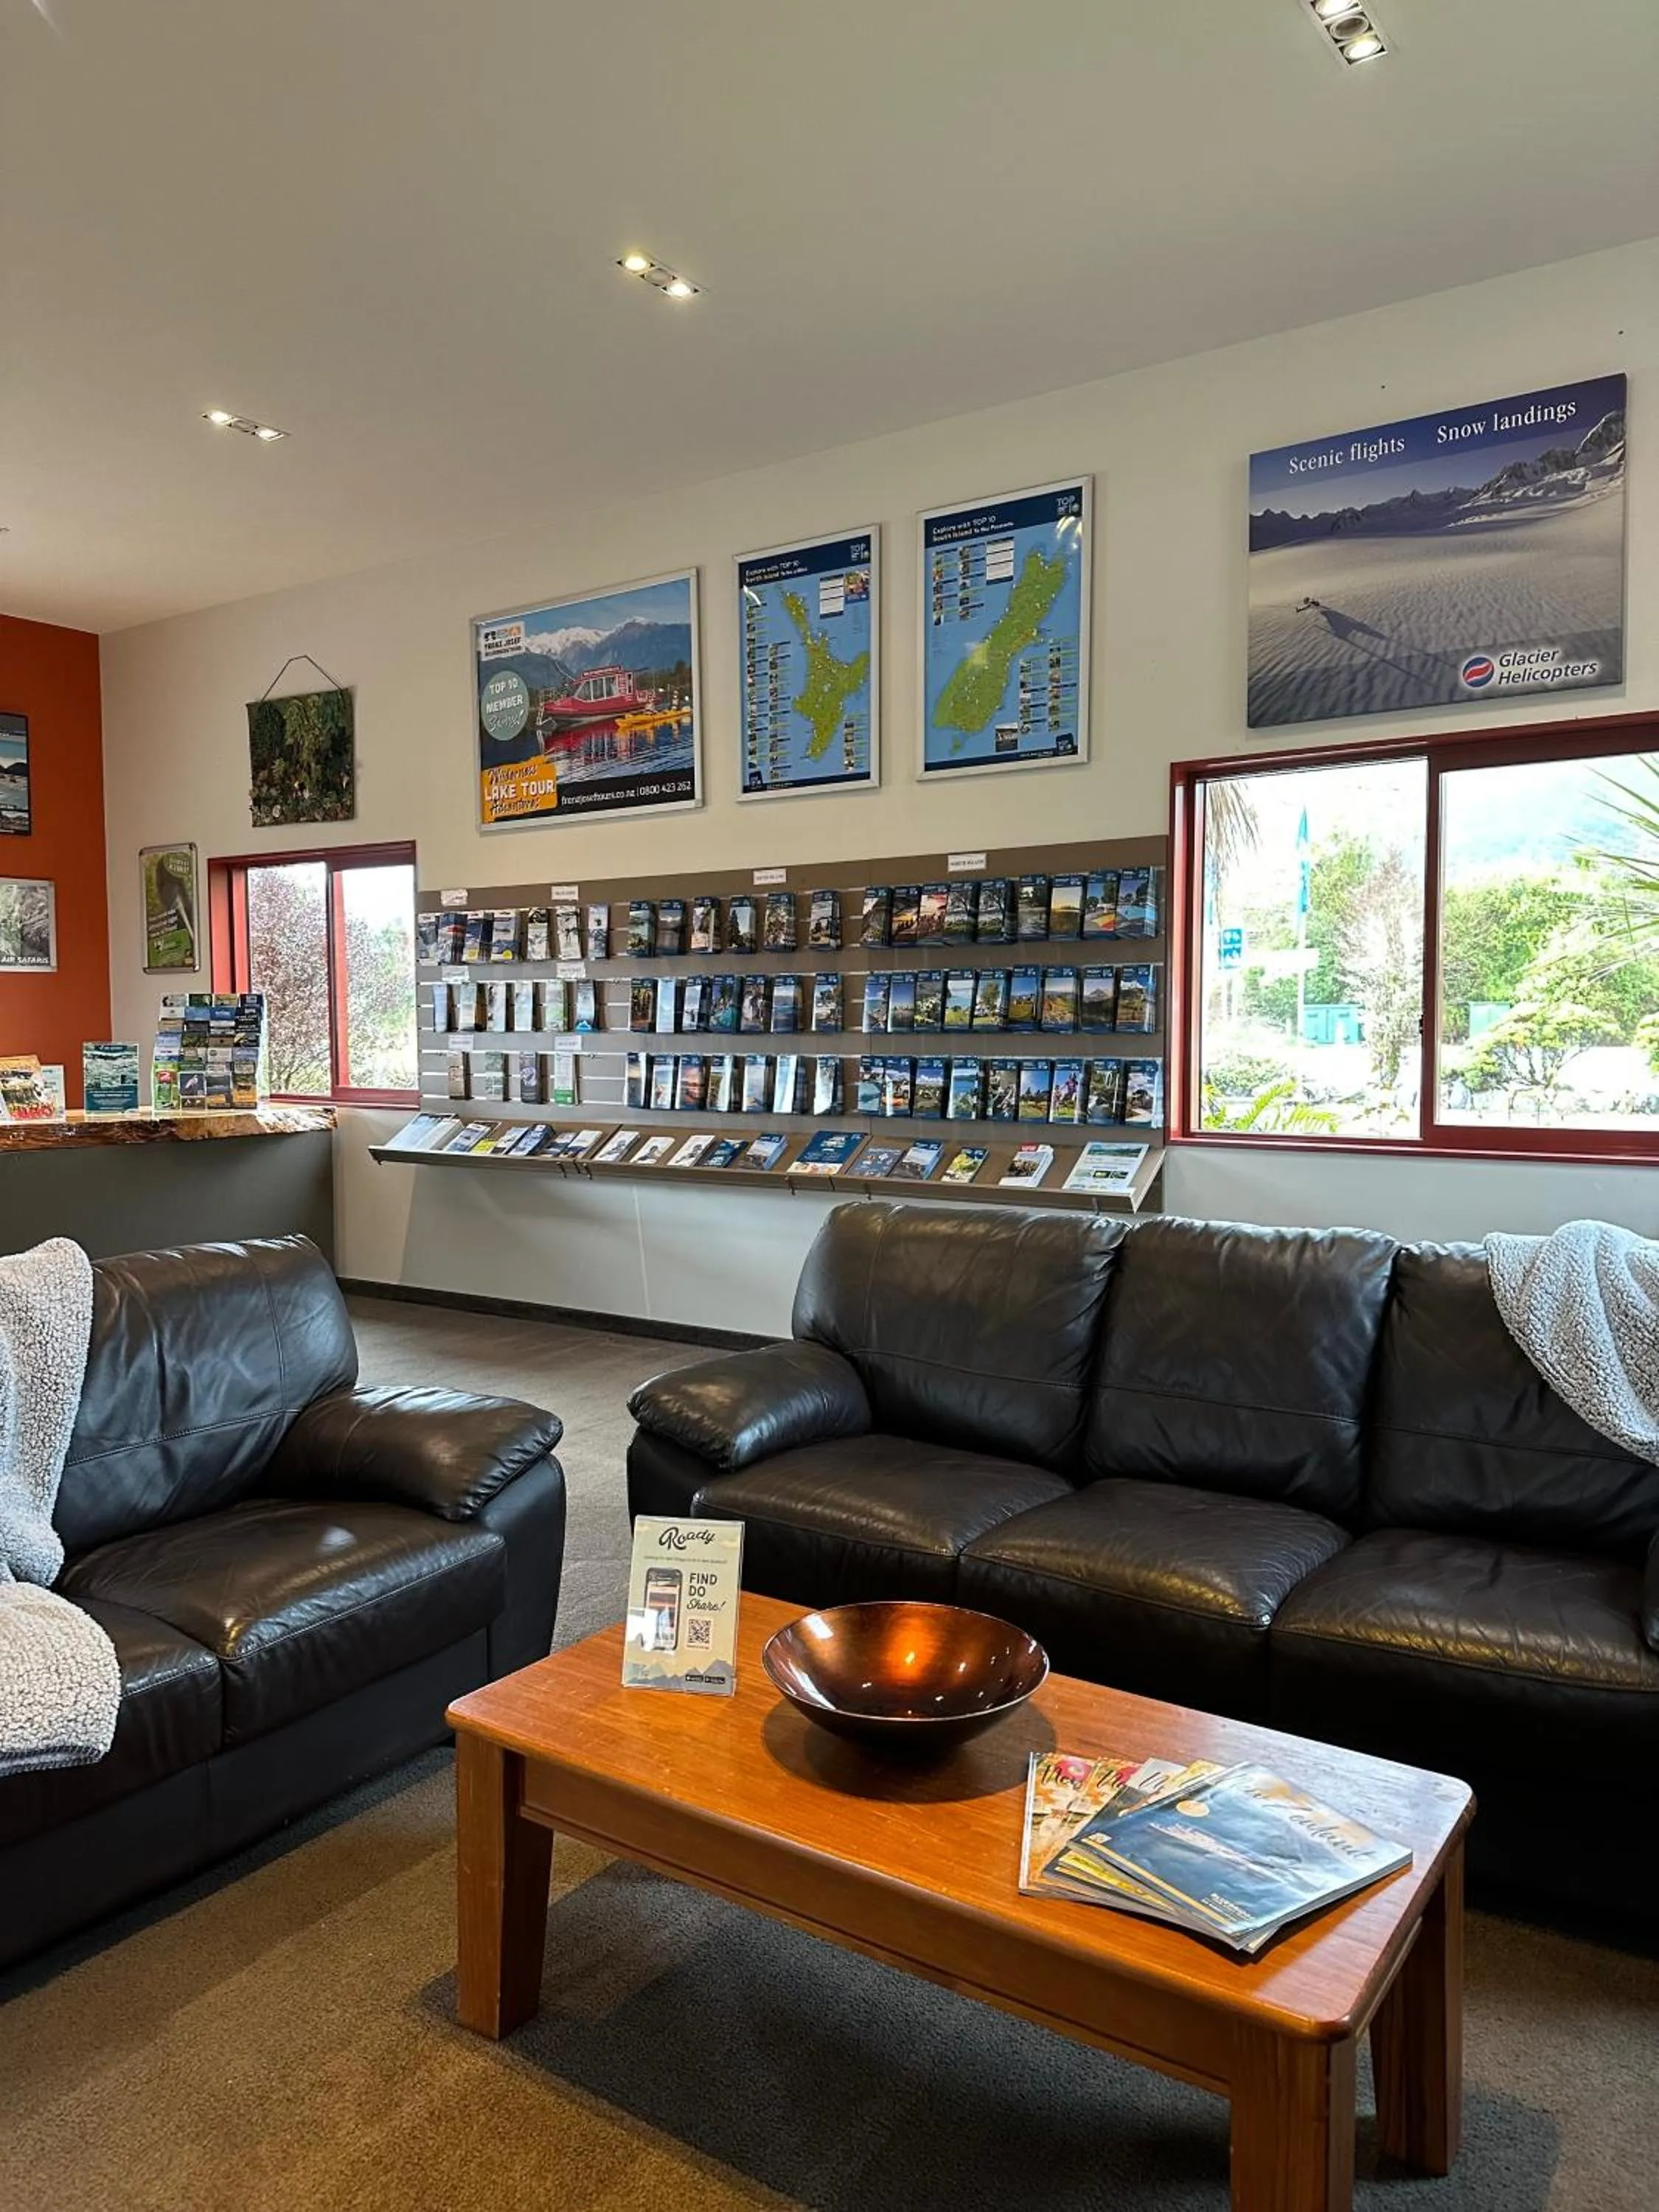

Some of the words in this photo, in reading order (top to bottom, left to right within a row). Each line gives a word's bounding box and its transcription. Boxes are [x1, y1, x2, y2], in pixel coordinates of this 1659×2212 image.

[1437, 421, 1486, 443] Snow
[1493, 402, 1576, 431] landings
[1289, 449, 1343, 474] Scenic
[1350, 438, 1405, 462] flights
[973, 518, 988, 528] TOP
[1499, 649, 1559, 667] Glacier
[1498, 662, 1598, 685] Helicopters
[490, 681, 507, 695] TOP
[508, 677, 518, 689] 10
[486, 695, 524, 714] MEMBER
[484, 783, 517, 802] LAKE
[521, 779, 554, 796] TOUR
[639, 785, 660, 796] 0800
[661, 782, 676, 793] 423
[658, 1526, 715, 1551] Roady
[689, 1573, 717, 1585] FIND
[689, 1585, 706, 1597] DO
